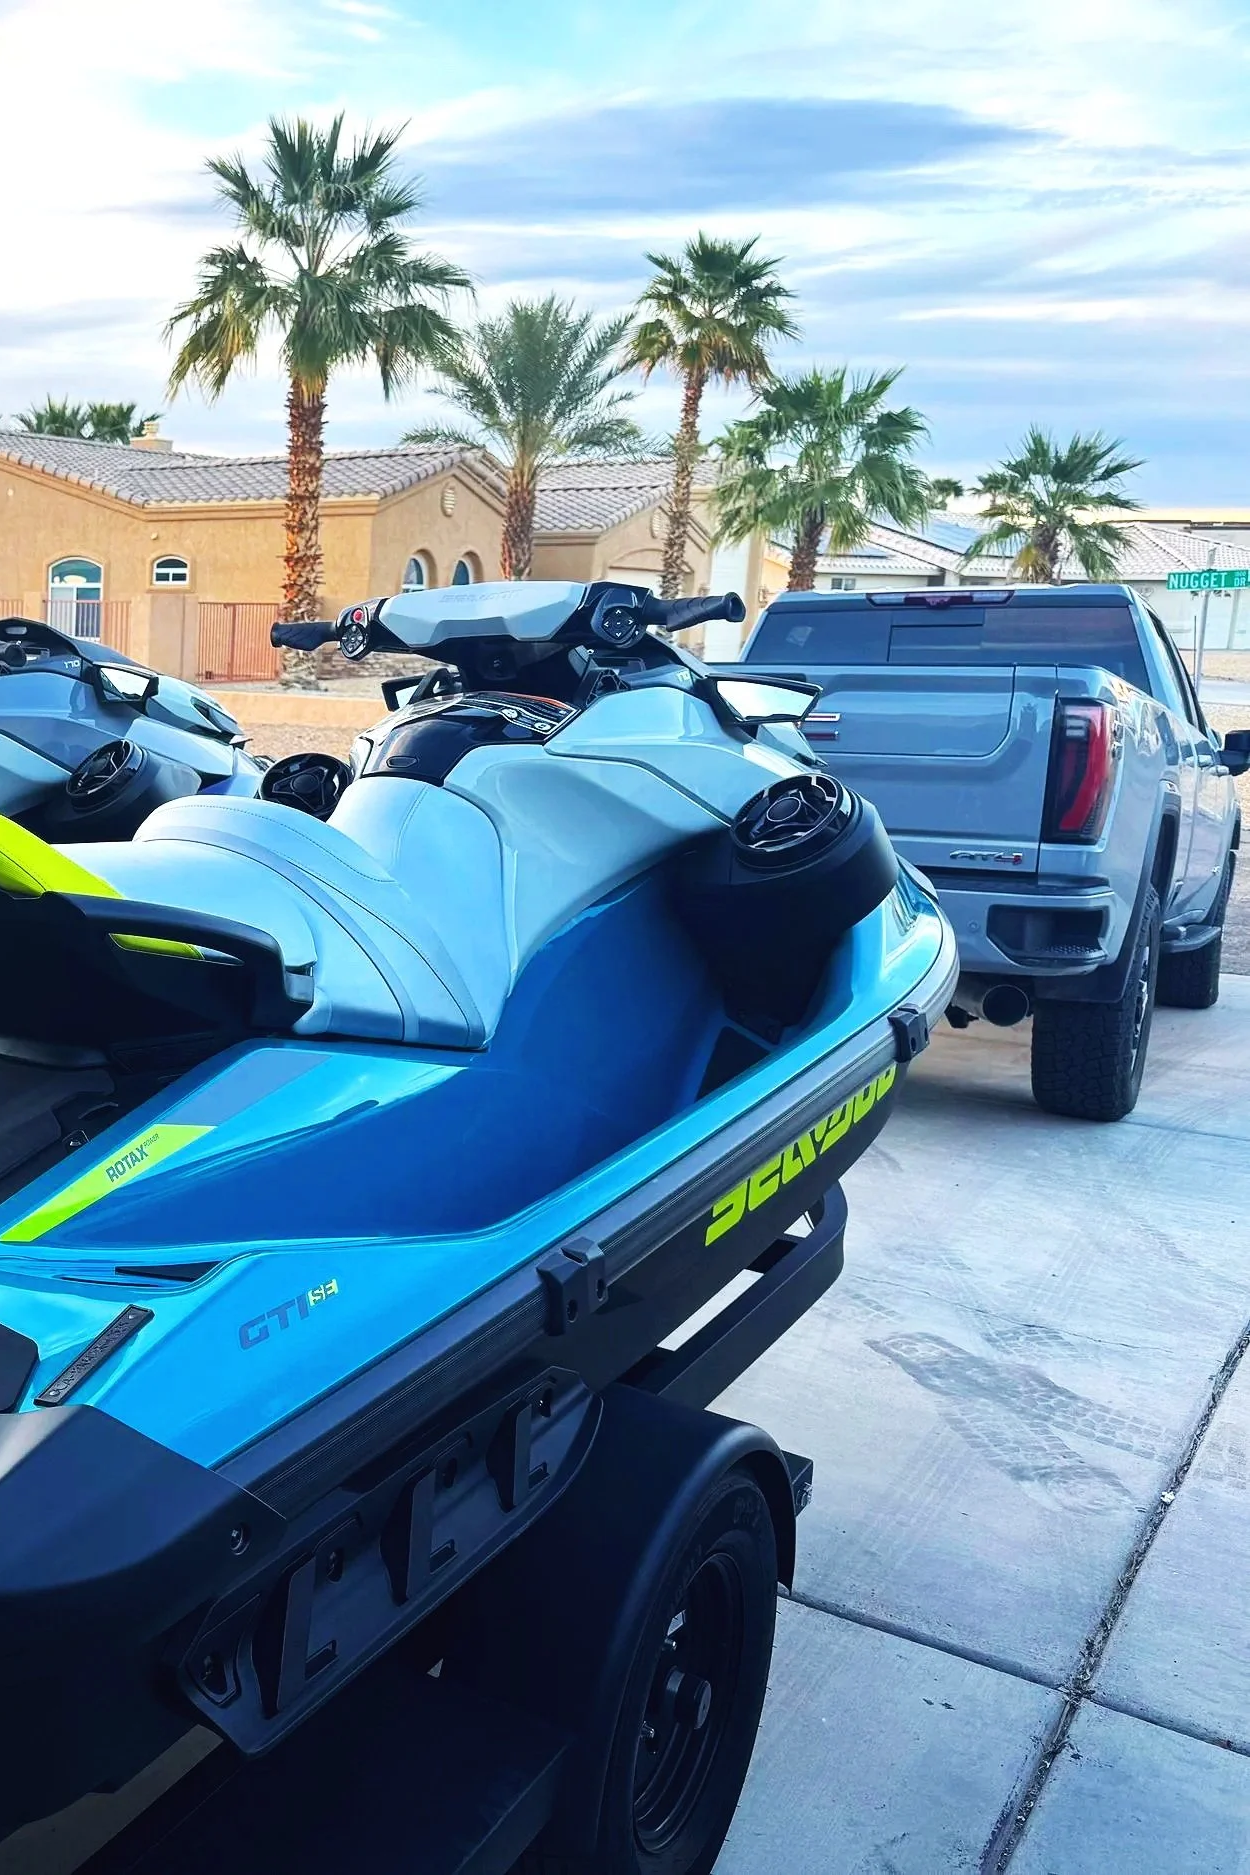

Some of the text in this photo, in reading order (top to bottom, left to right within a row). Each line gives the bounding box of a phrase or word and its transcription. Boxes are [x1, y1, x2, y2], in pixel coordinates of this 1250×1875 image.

[1169, 573, 1246, 589] NUGGET DR
[105, 1144, 149, 1183] ROTAX
[239, 1278, 339, 1350] GTI SE
